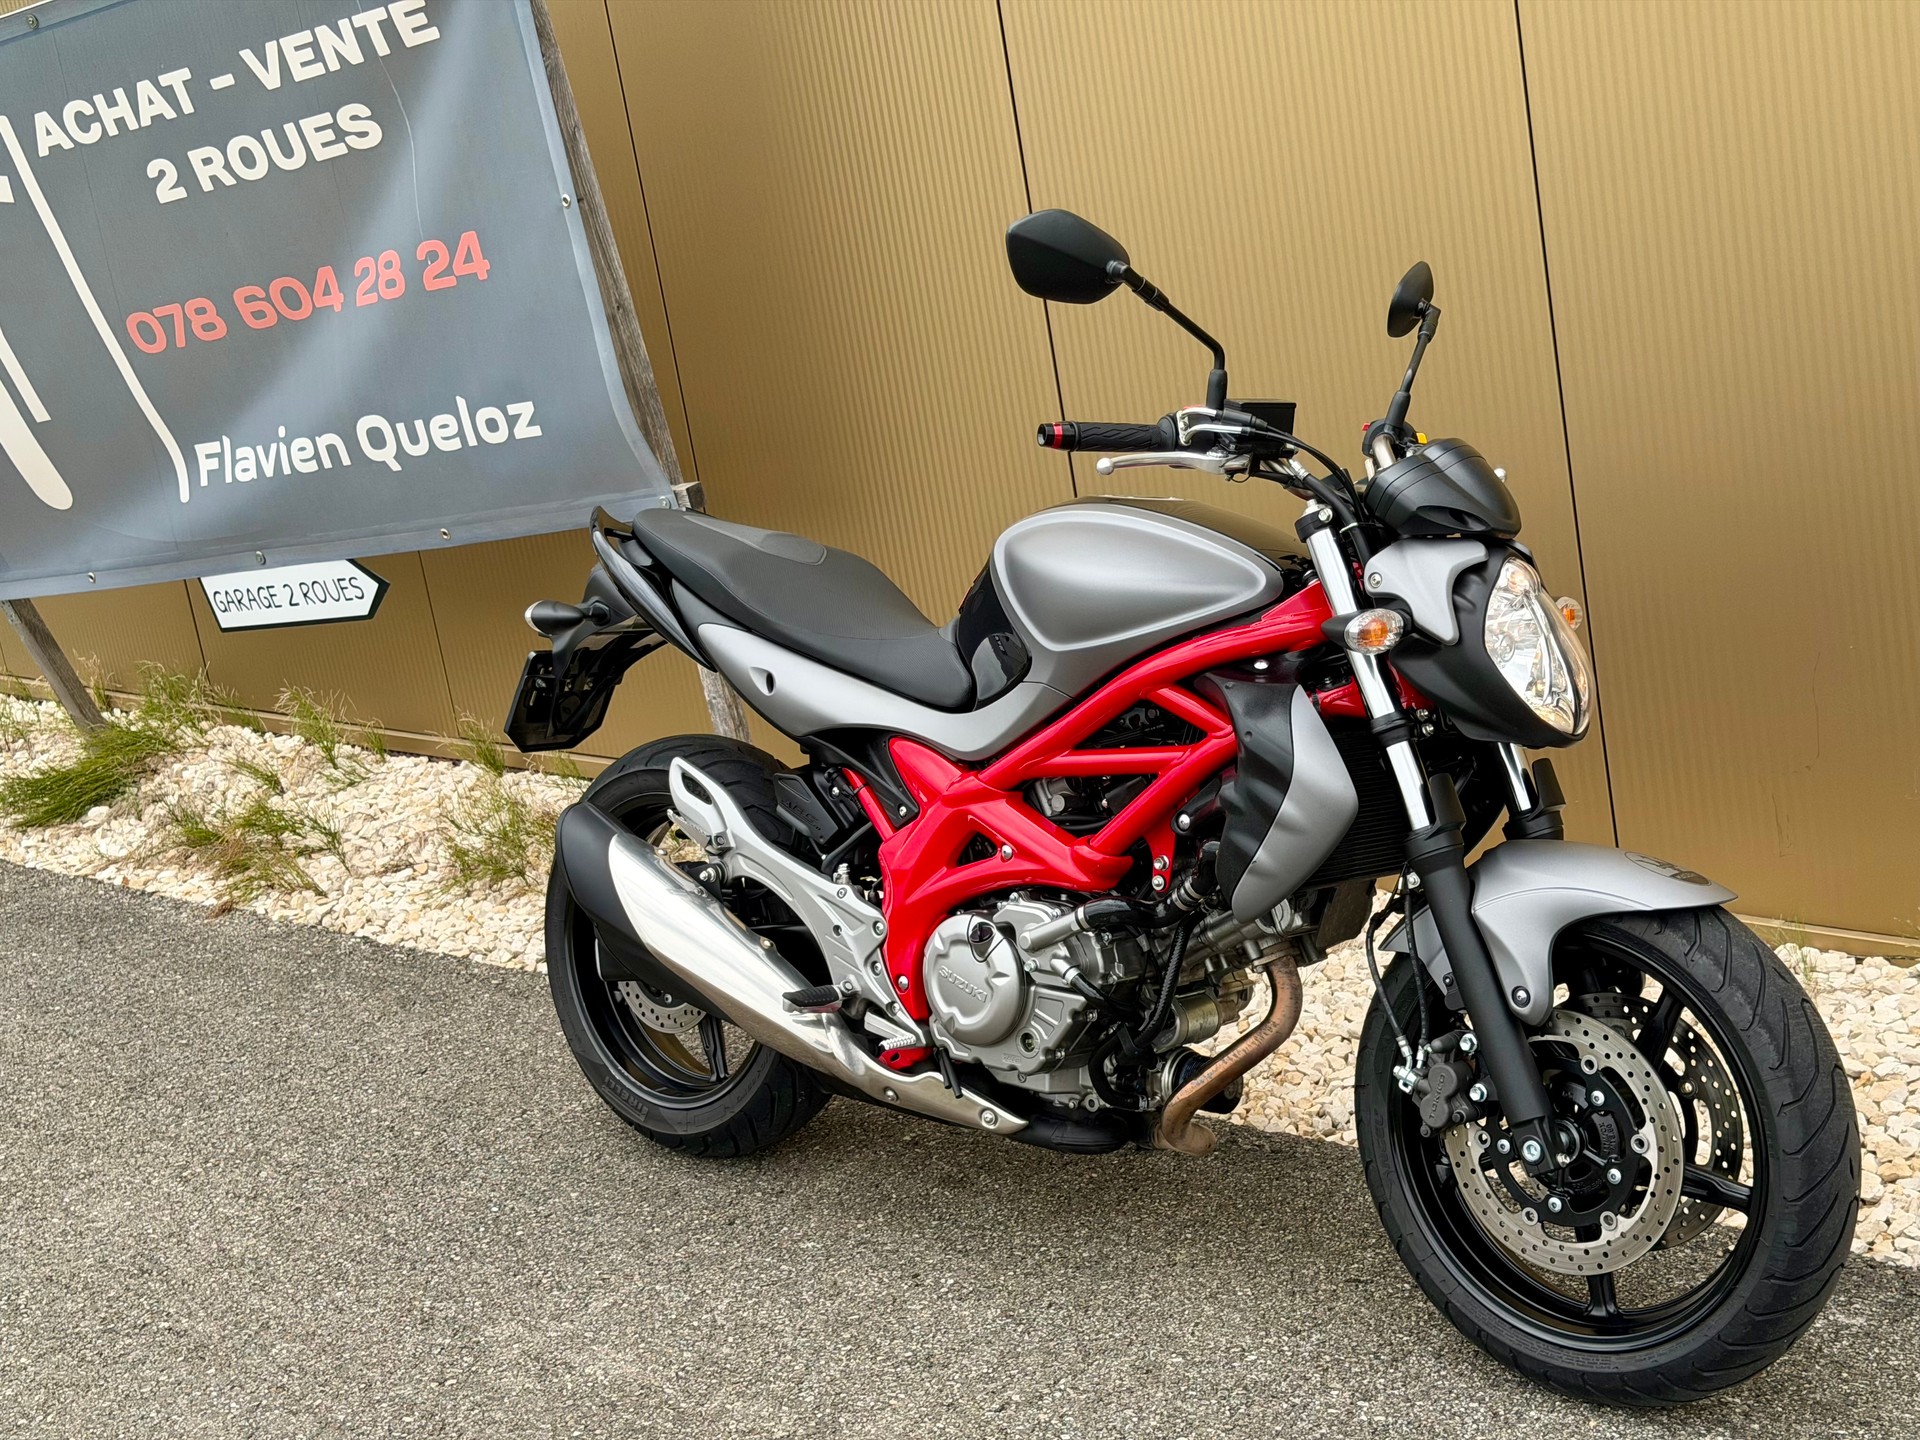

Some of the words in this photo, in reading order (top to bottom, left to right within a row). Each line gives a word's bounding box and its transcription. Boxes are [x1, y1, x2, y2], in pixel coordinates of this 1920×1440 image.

[34, 67, 195, 158] ACHAT
[238, 0, 441, 91] VENTE
[146, 158, 188, 204] 2
[187, 103, 383, 192] ROUES
[126, 297, 228, 354] 078
[233, 266, 344, 330] 604
[354, 250, 406, 307] 28
[416, 231, 491, 291] 24
[194, 426, 352, 487] Flavien
[356, 395, 543, 472] Queloz
[213, 585, 283, 614] GARAGE
[282, 583, 300, 607] 2
[299, 576, 365, 606] ROUES
[938, 965, 988, 1004] SUZUKI
[602, 1076, 649, 1121] PIRELLI
[1428, 1072, 1447, 1120] TOKICO
